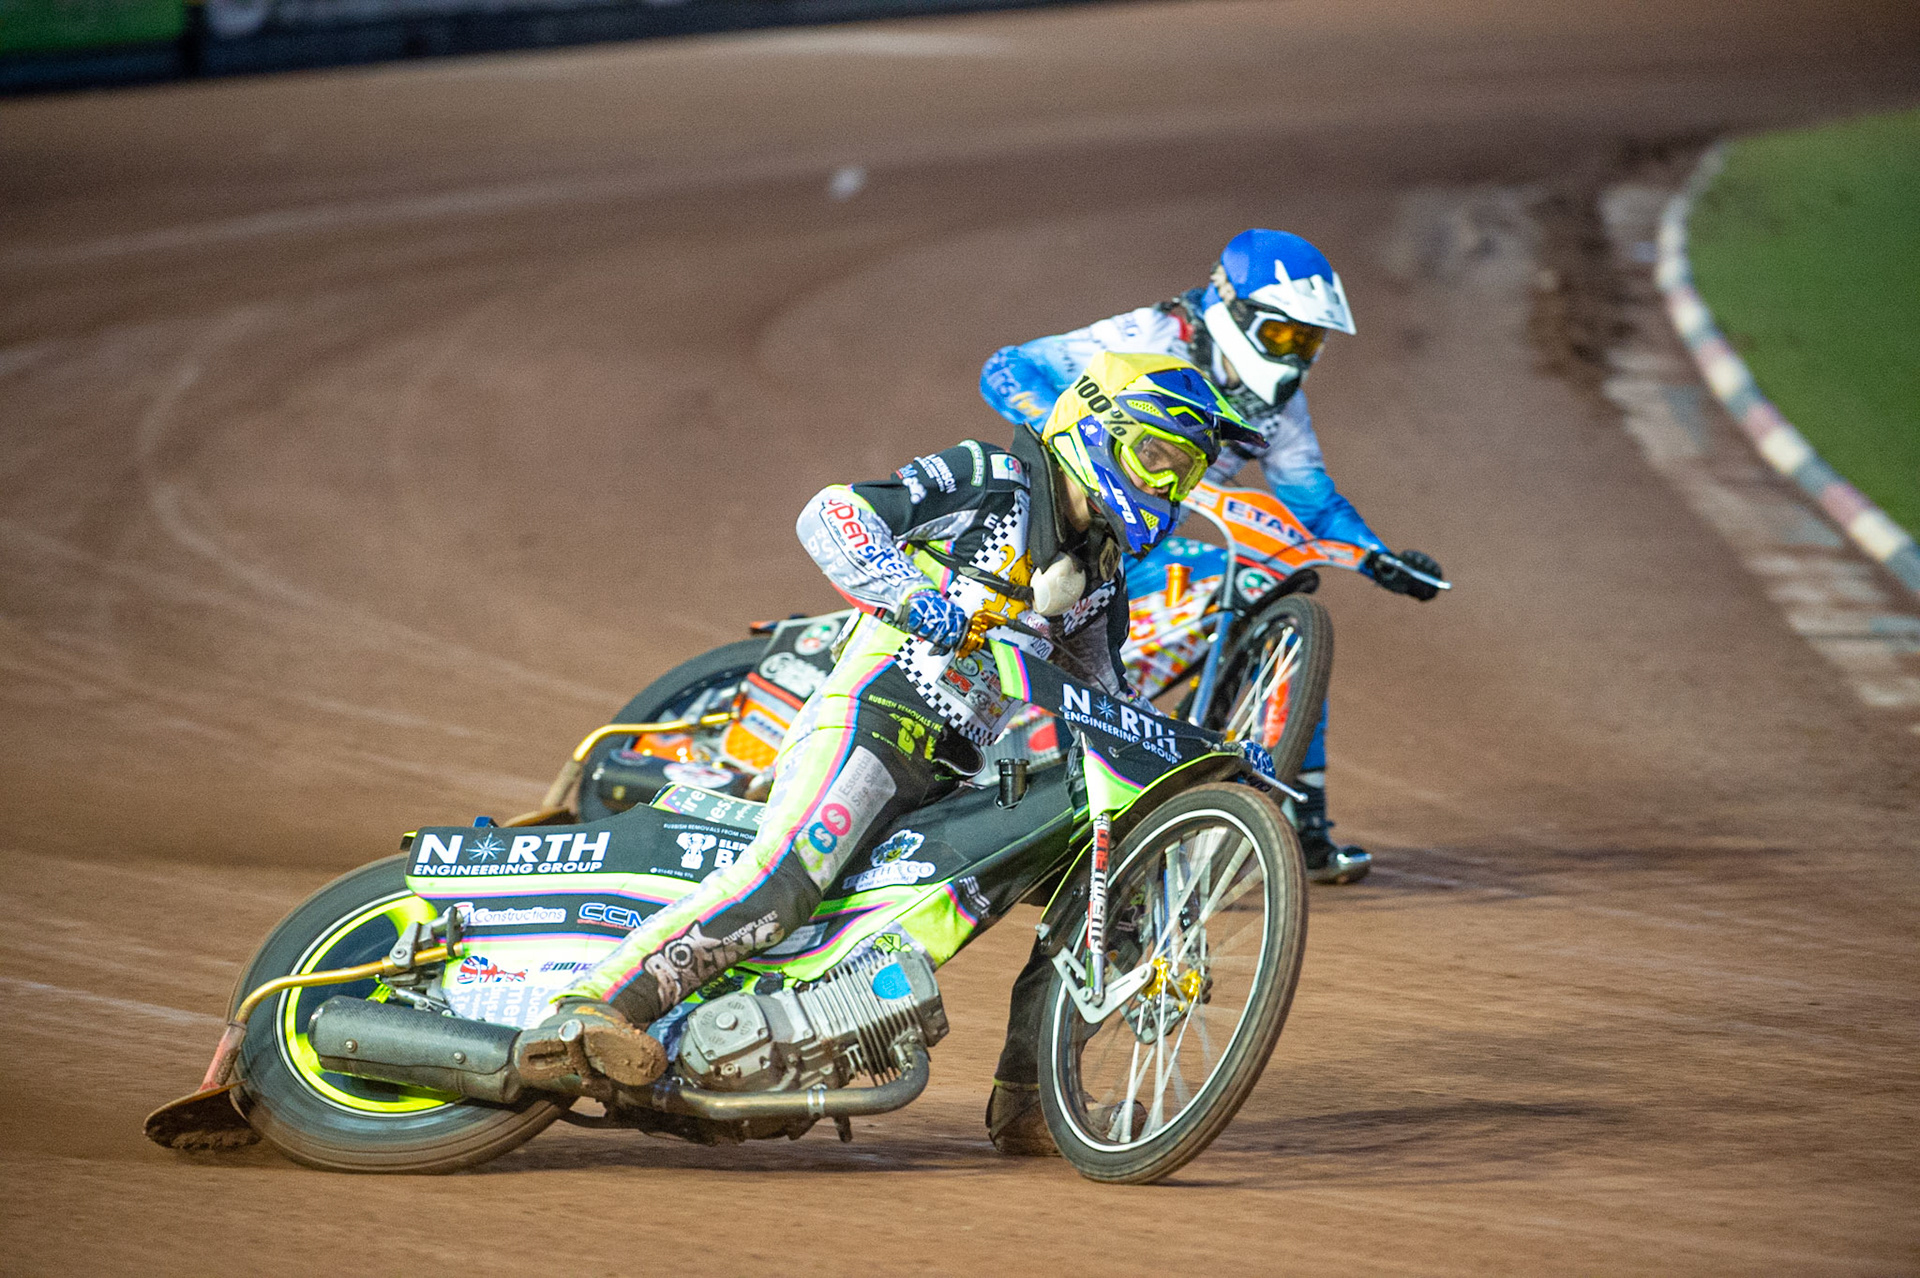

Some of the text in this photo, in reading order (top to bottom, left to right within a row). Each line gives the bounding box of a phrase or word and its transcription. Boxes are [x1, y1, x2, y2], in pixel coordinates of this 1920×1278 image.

[1075, 375, 1137, 437] 100%
[1064, 711, 1140, 743] ENGINEERING
[1142, 741, 1178, 765] GROUP
[413, 861, 603, 876] ENGINEERING GROUP
[475, 907, 563, 923] Constructions
